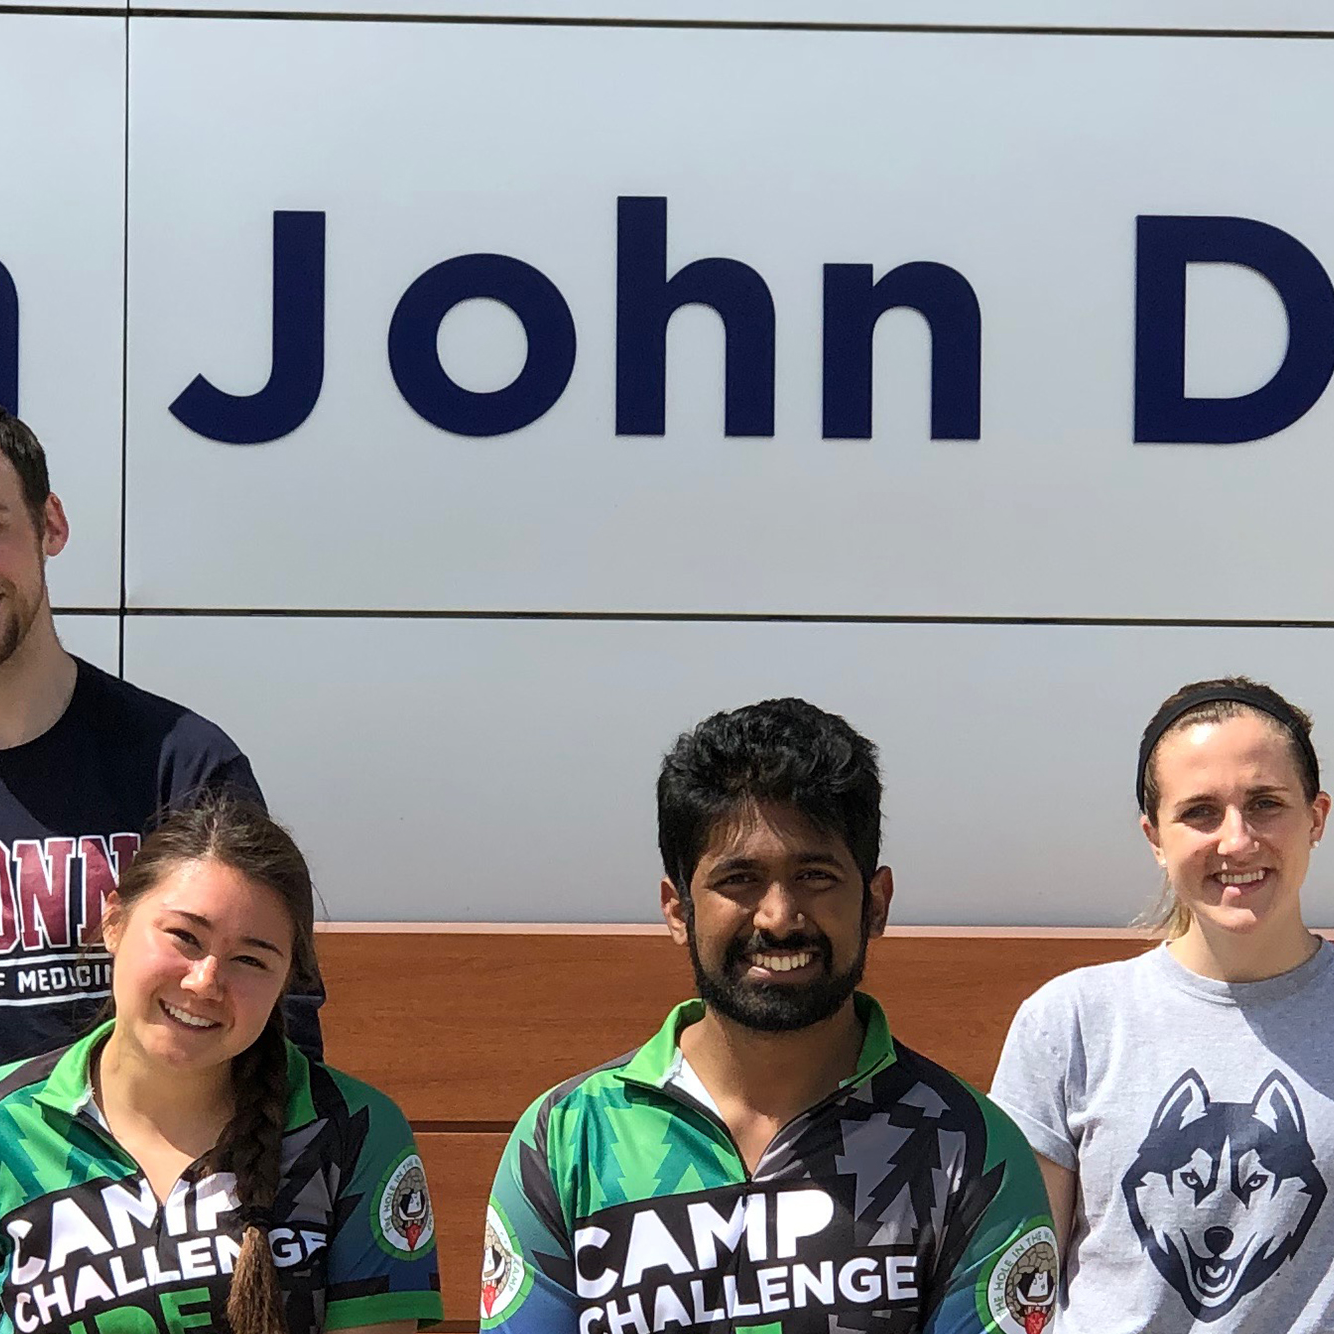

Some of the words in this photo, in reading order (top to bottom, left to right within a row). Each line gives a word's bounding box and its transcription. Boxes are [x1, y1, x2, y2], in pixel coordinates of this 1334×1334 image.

[167, 196, 982, 445] John
[18, 964, 111, 993] MEDICI
[7, 1172, 243, 1285] CAMP
[575, 1189, 834, 1299] CAMP
[994, 1259, 1012, 1291] HOLE
[1012, 1245, 1024, 1258] IN
